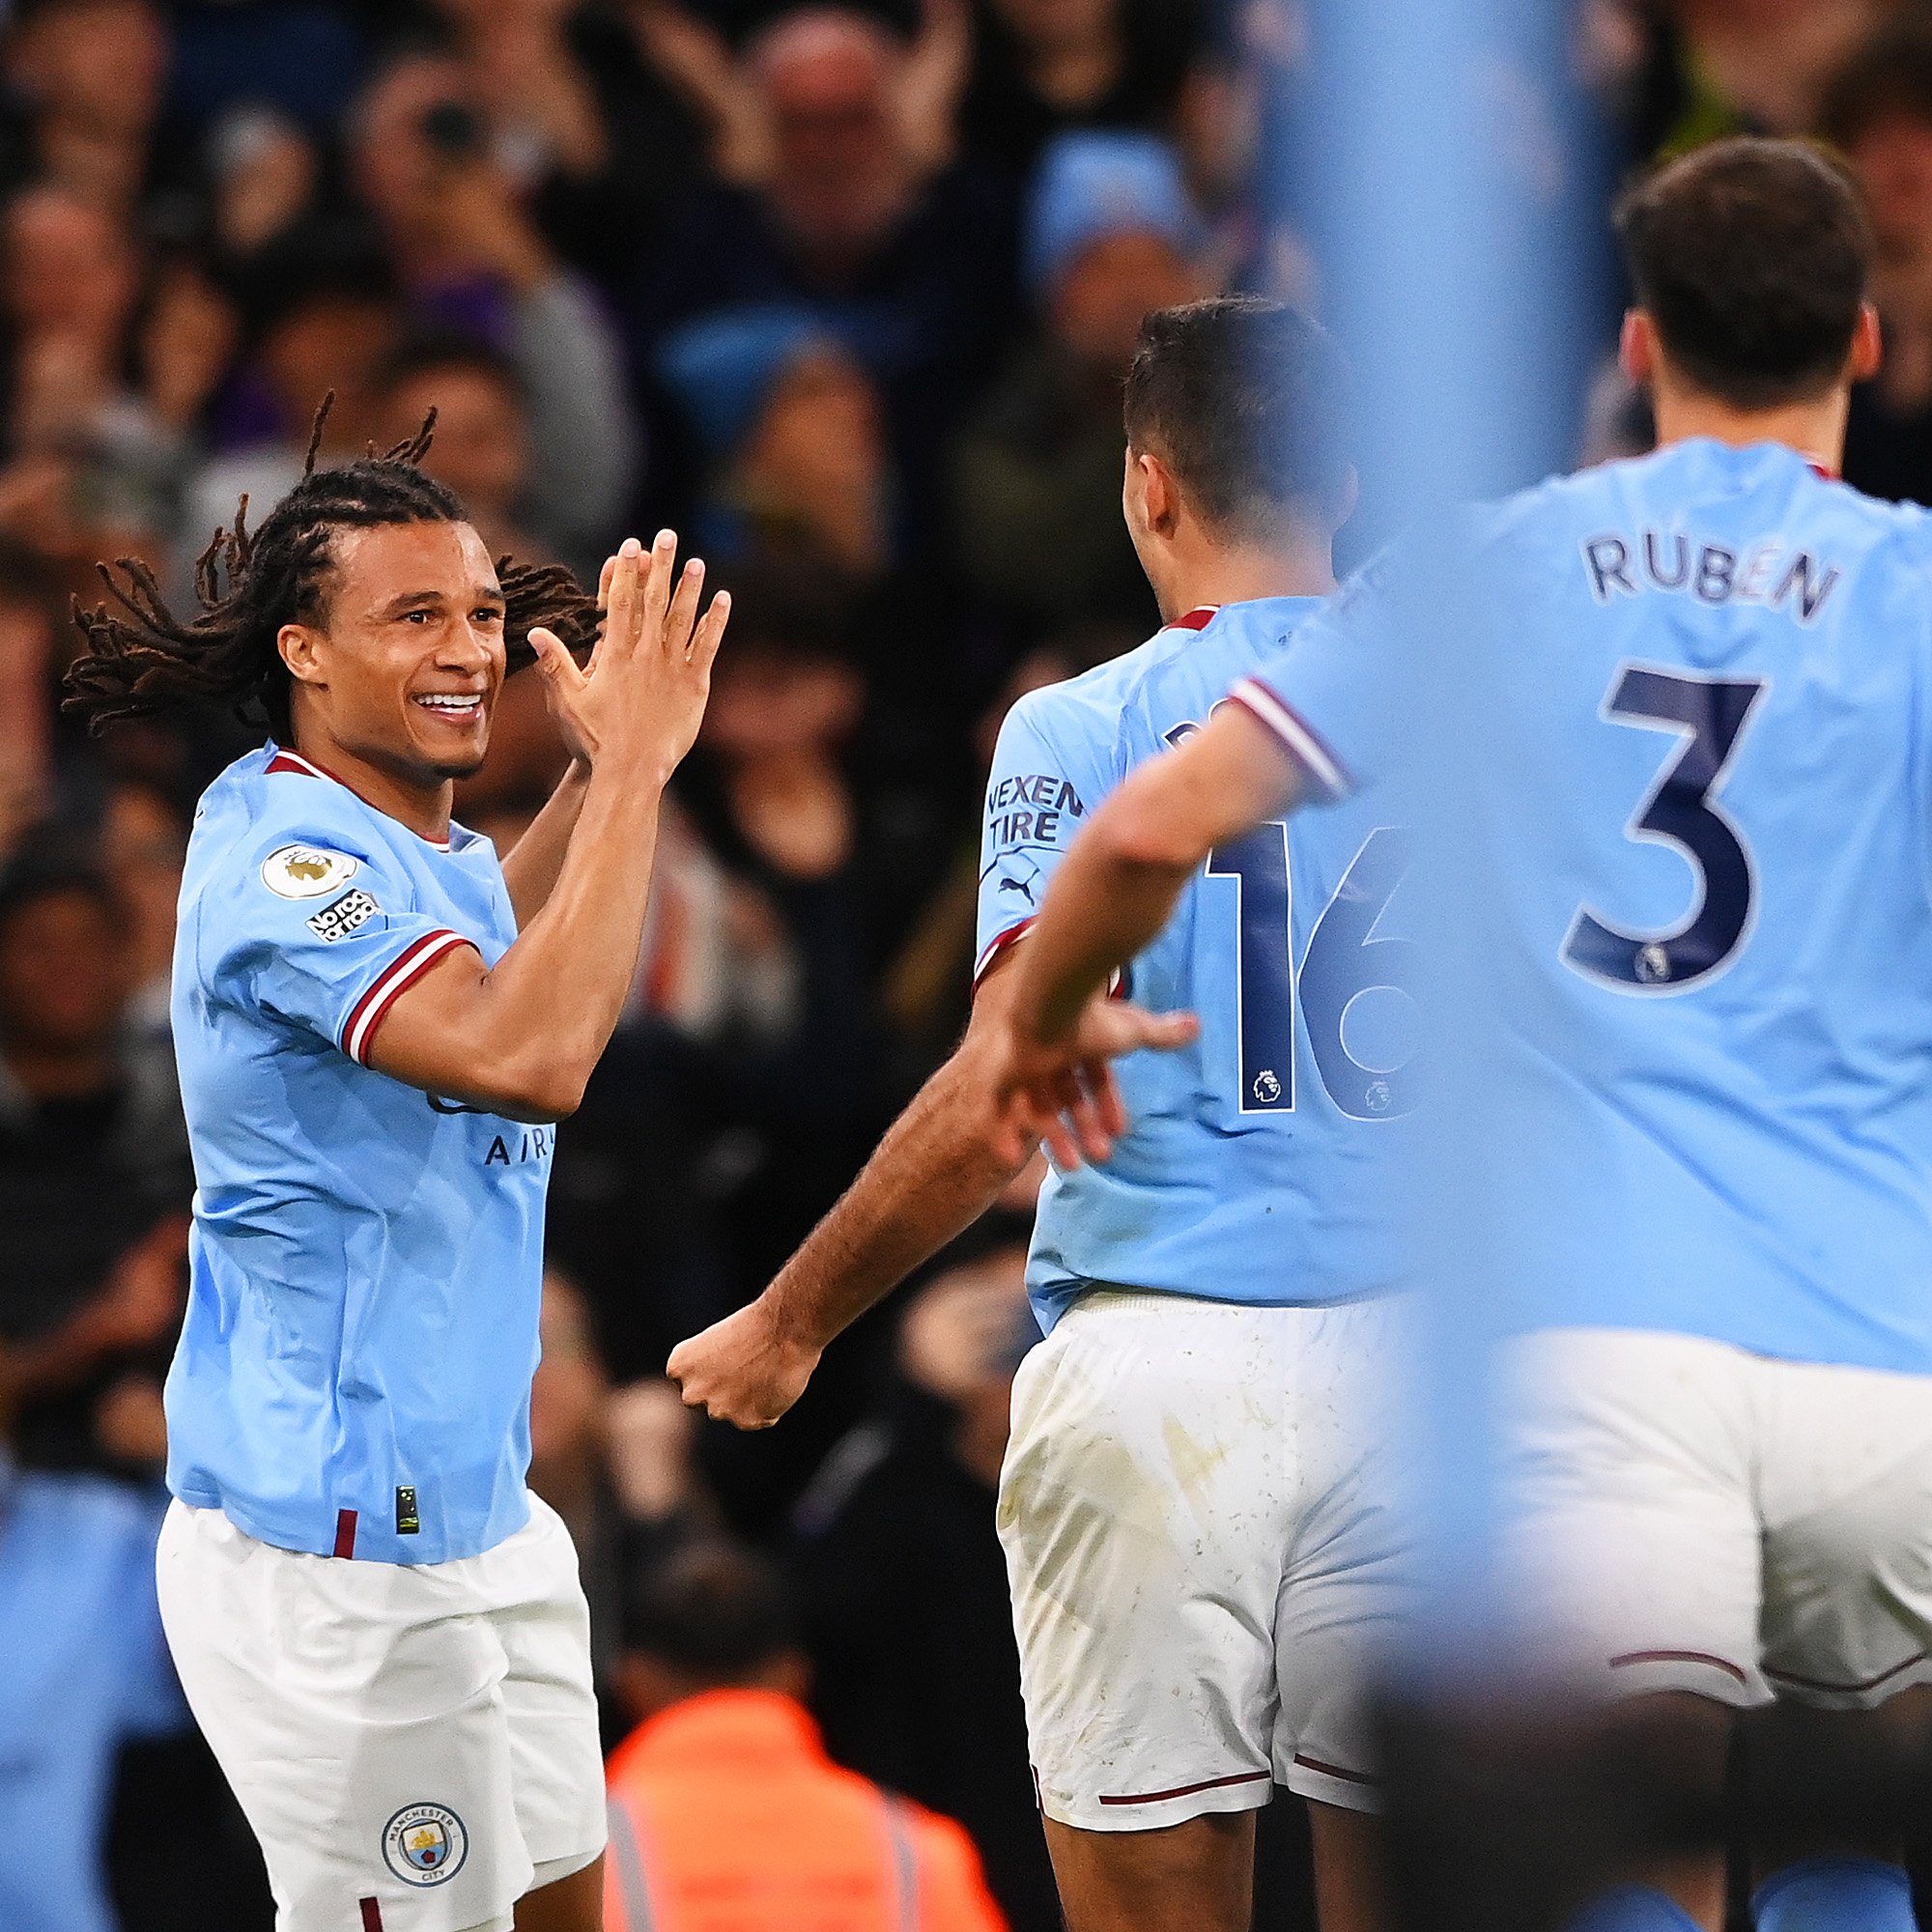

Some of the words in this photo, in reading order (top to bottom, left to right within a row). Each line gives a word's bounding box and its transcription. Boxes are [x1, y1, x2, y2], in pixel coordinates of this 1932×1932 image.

[989, 811, 1060, 850] TIRE
[1558, 661, 1770, 998] 3
[1205, 821, 1420, 1122] 16
[389, 1808, 453, 1841] MANCHESTER
[422, 1869, 444, 1881] CITY
